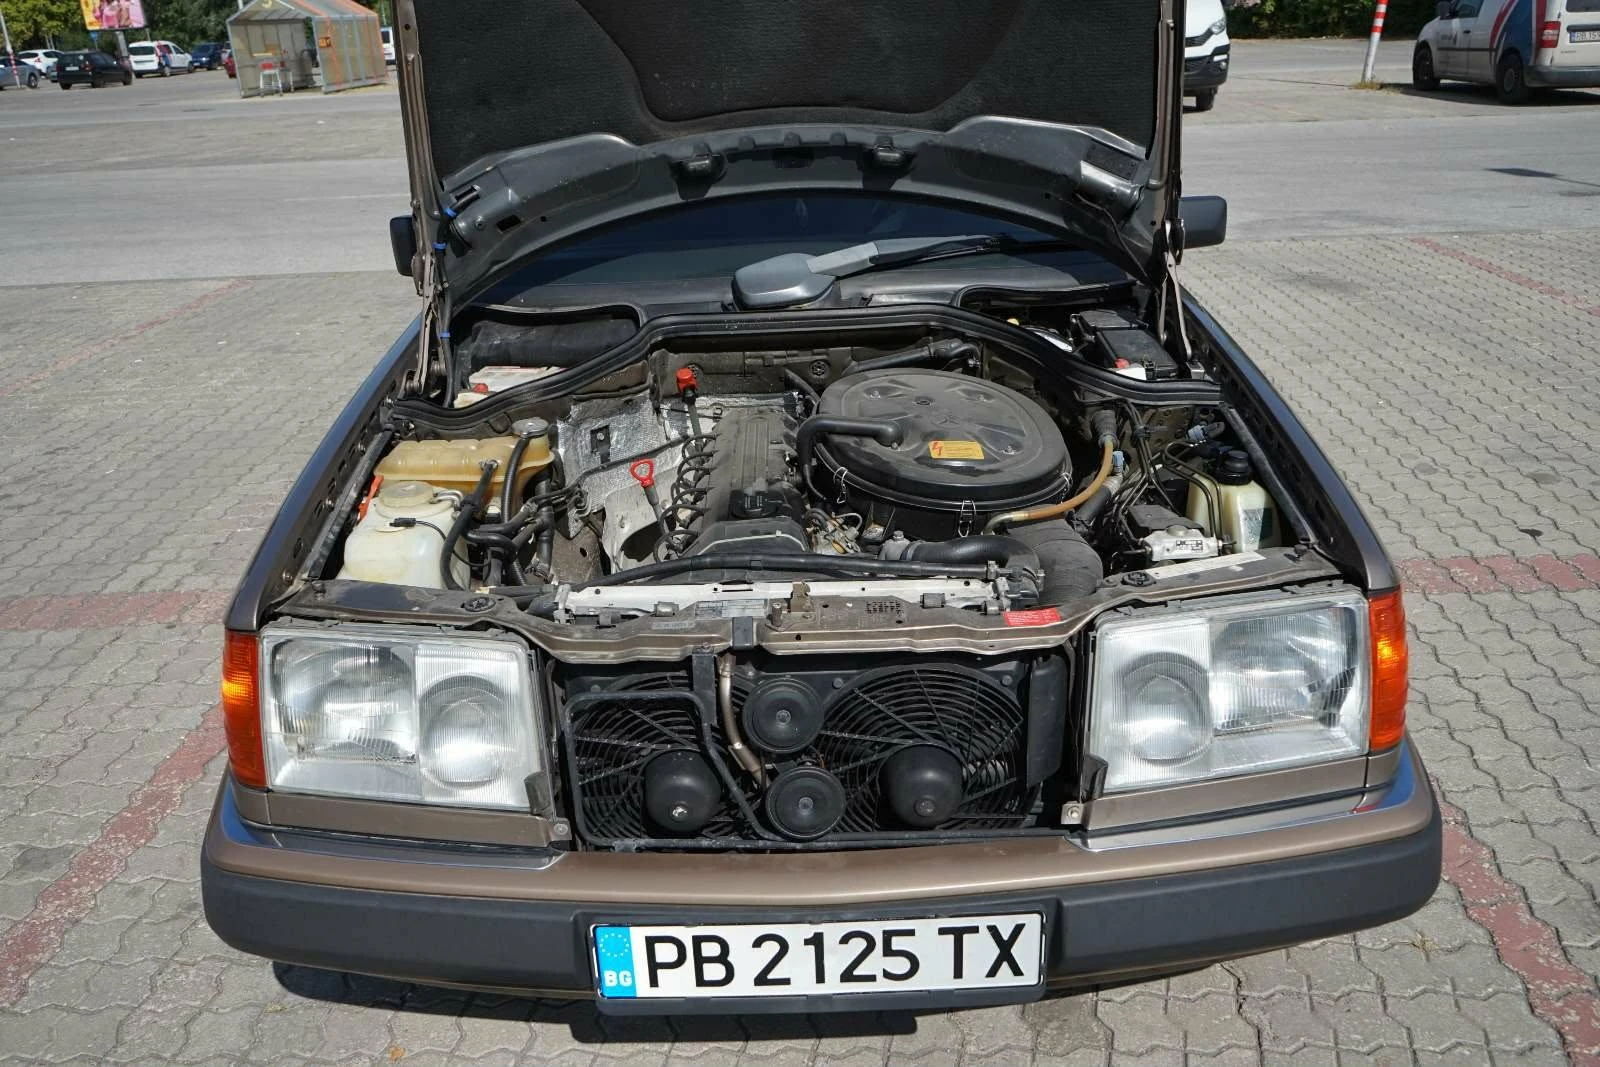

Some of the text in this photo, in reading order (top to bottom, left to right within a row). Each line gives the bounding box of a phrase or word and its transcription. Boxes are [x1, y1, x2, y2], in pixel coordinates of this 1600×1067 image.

[644, 922, 1026, 988] PB 2125 TX
[603, 969, 633, 987] BG
